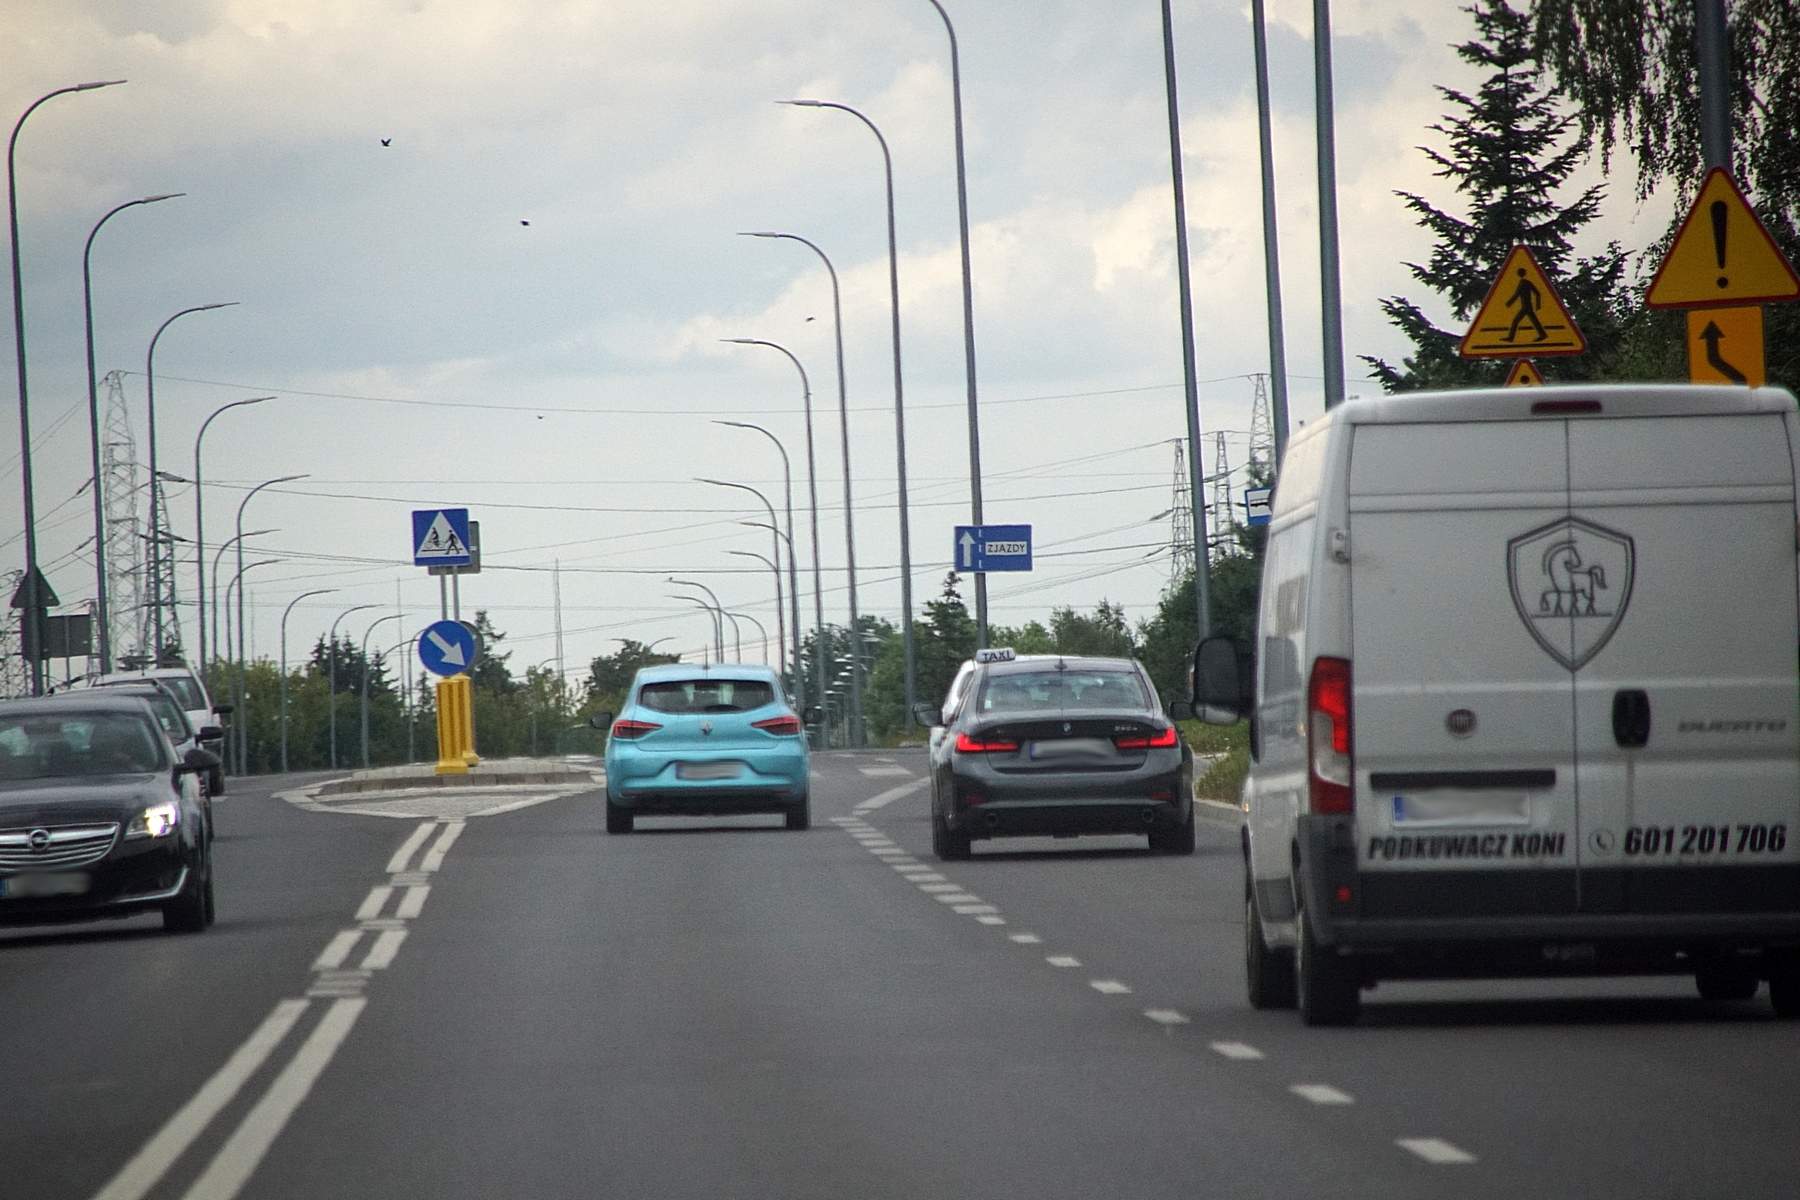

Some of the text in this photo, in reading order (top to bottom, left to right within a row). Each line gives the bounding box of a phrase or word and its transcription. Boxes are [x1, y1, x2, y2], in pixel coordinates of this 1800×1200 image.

[988, 543, 1026, 553] ZJAZDY
[982, 650, 1010, 661] TAXI
[1369, 832, 1565, 860] PODKUWACZ KONI
[1624, 823, 1787, 855] 601 201 706
